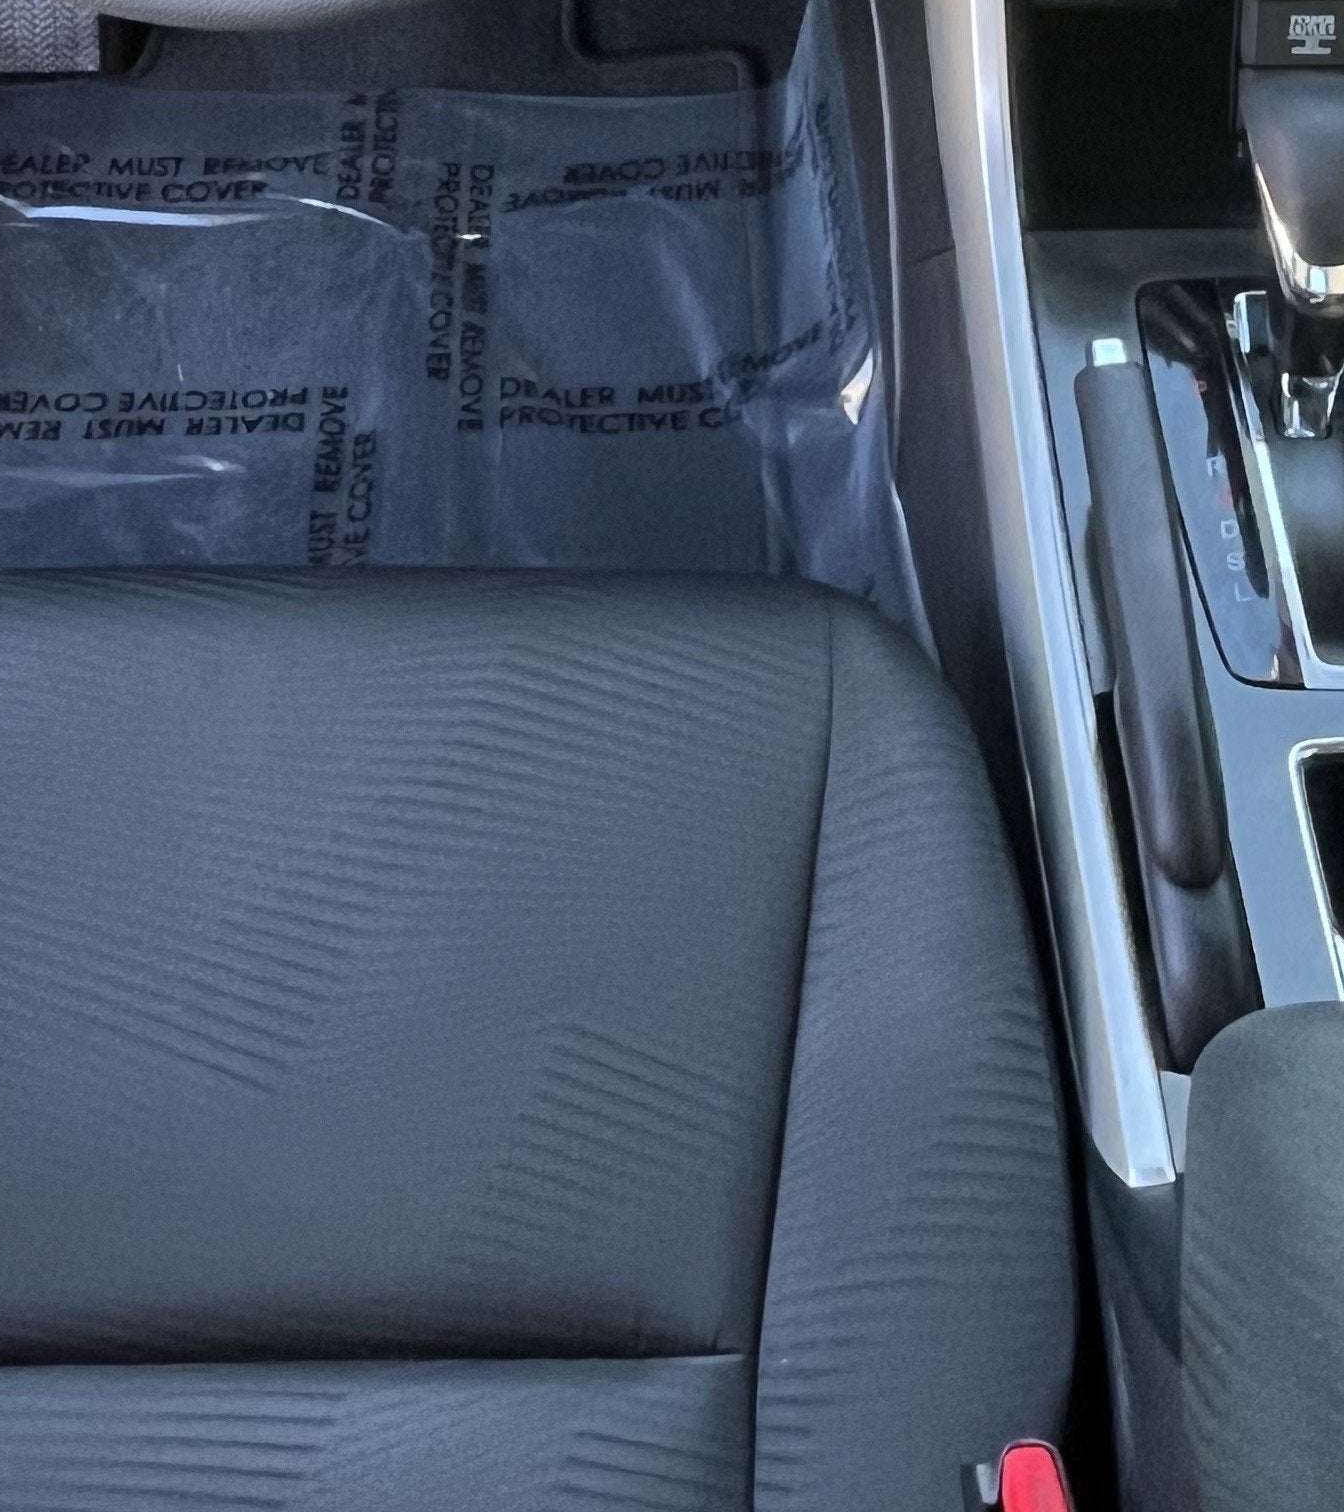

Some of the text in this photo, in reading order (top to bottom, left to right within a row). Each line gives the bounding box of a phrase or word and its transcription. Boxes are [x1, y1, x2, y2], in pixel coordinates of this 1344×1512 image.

[108, 155, 184, 178] MUST
[160, 179, 269, 204] COVER
[118, 387, 309, 414] PROTECTIVE
[499, 377, 616, 407] DEALER
[637, 378, 714, 404] MUST
[83, 414, 166, 439] MUST
[185, 410, 306, 437] DEALER
[499, 406, 688, 434] PROTECTIVE
[314, 386, 350, 492] REMOVE
[1235, 583, 1254, 602] L
